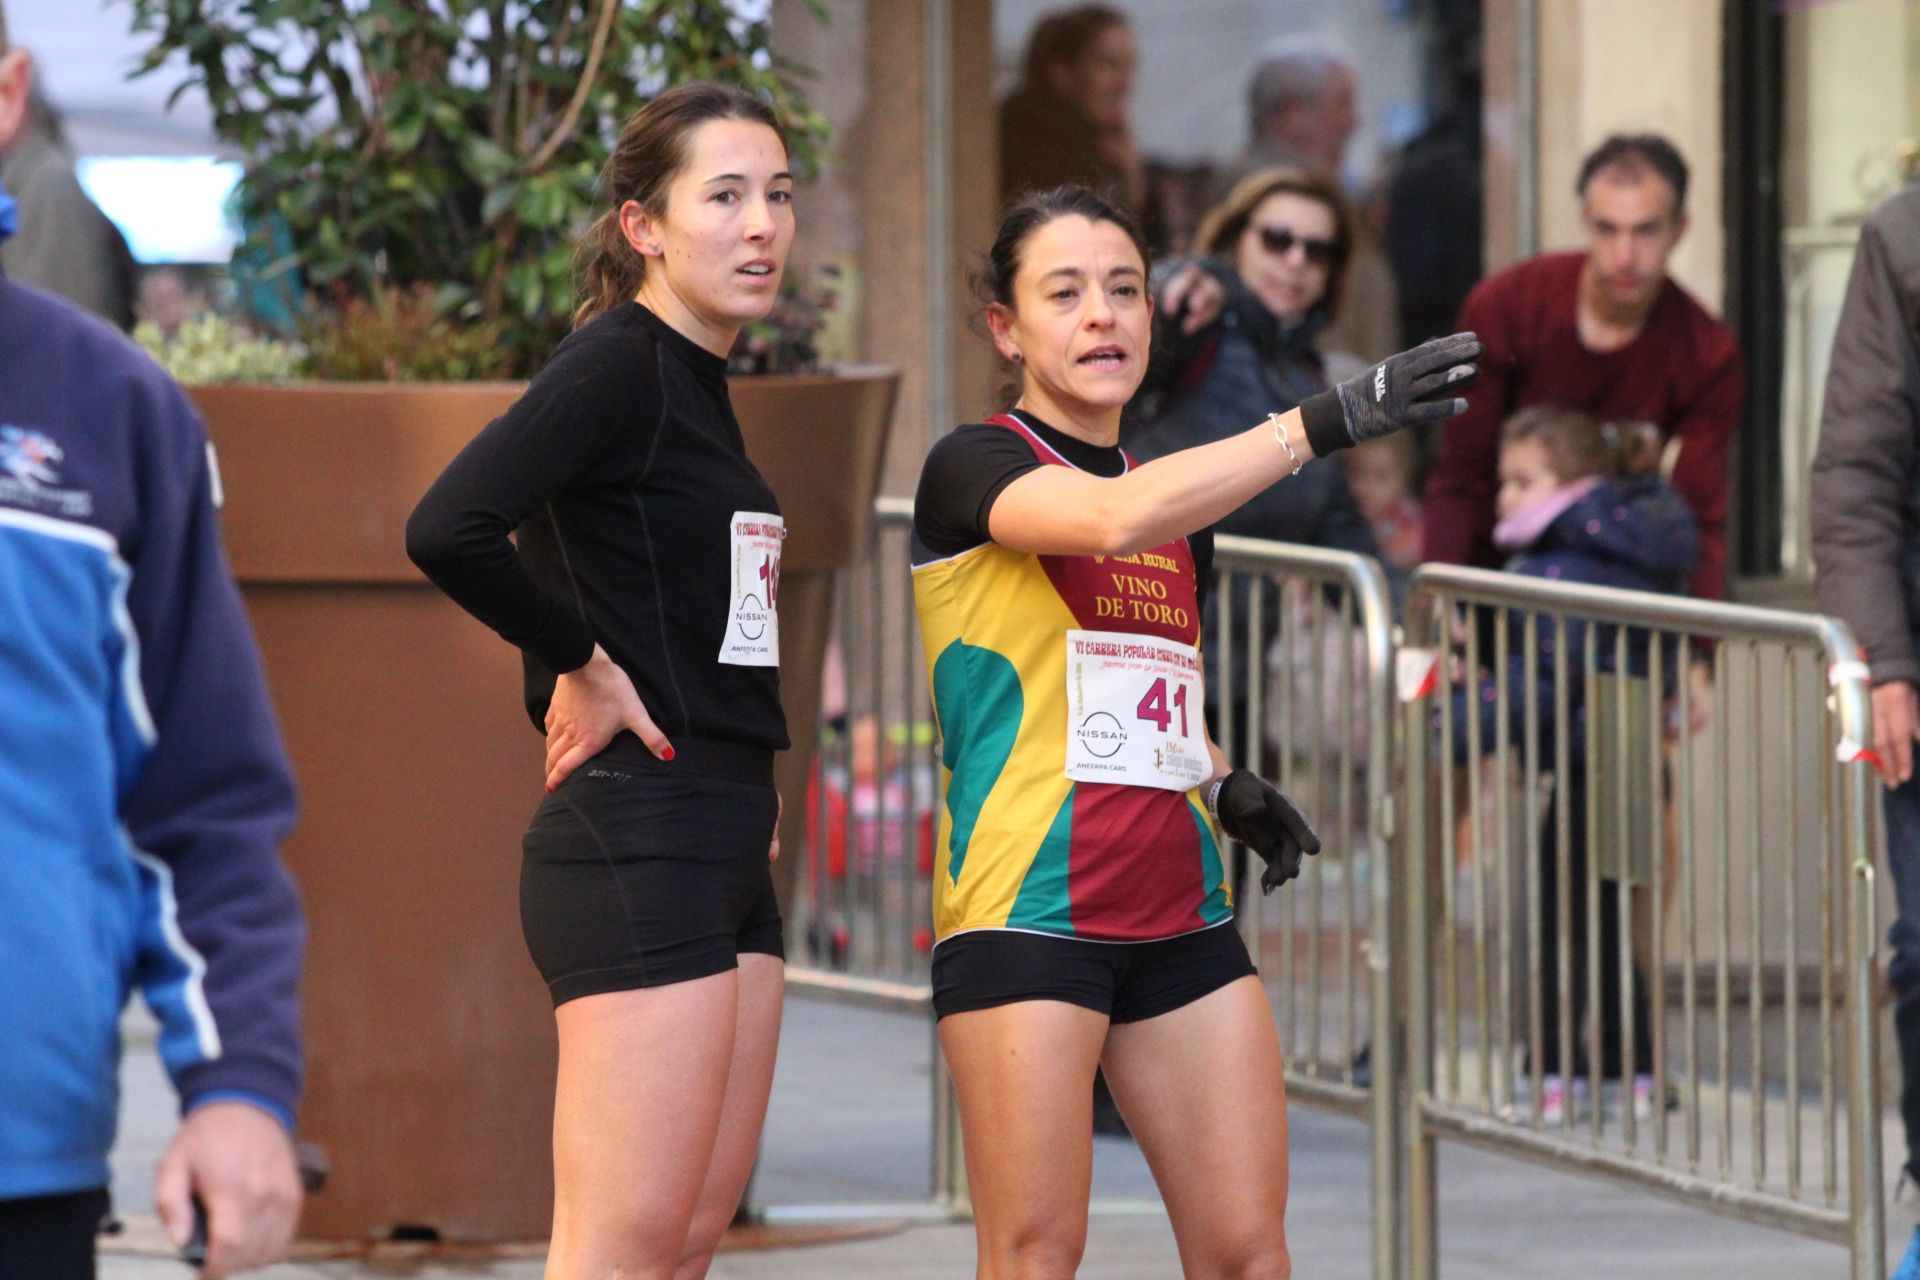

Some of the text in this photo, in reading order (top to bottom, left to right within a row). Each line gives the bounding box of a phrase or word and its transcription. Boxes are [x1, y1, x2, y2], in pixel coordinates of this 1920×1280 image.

[1141, 552, 1179, 574] RURAL
[1111, 573, 1167, 600] VINO
[736, 613, 768, 621] NISSAN
[1095, 596, 1188, 628] DE TORO
[1075, 640, 1084, 655] VI
[1085, 641, 1122, 659] CARRERA
[1123, 644, 1156, 660] POPULAR
[1136, 677, 1189, 738] 41
[1077, 729, 1128, 741] NISSAN
[1109, 764, 1127, 772] CARS
